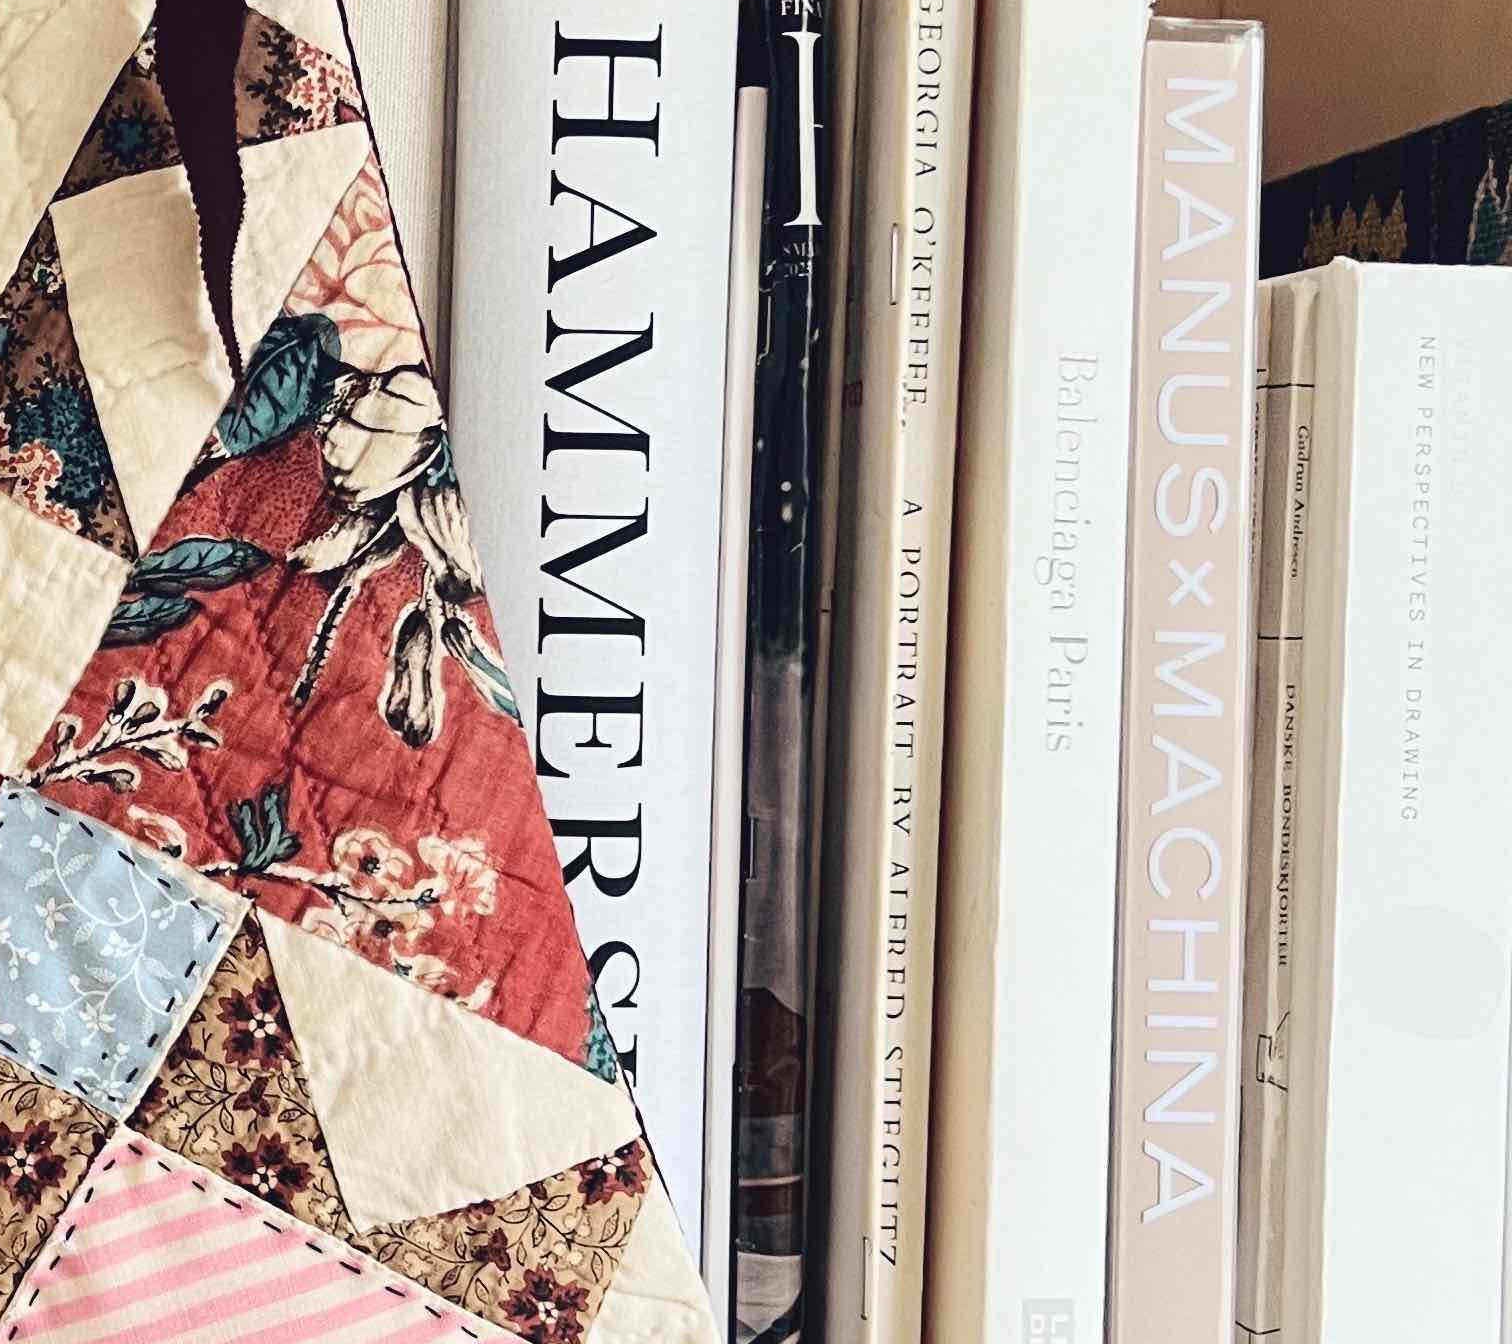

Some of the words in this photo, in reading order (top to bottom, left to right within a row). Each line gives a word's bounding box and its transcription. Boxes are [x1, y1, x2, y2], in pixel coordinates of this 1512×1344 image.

[1419, 336, 1436, 391] NEW
[536, 20, 663, 1088] HAMMERS
[1035, 354, 1098, 613] Balenciaga
[1409, 407, 1435, 622] PERSPECTIVES
[893, 547, 922, 759] PORTRAIT
[1046, 635, 1089, 752] Paris
[1407, 641, 1424, 671] IN
[1401, 687, 1421, 821] DRAWING
[885, 862, 911, 1020] ALFRED
